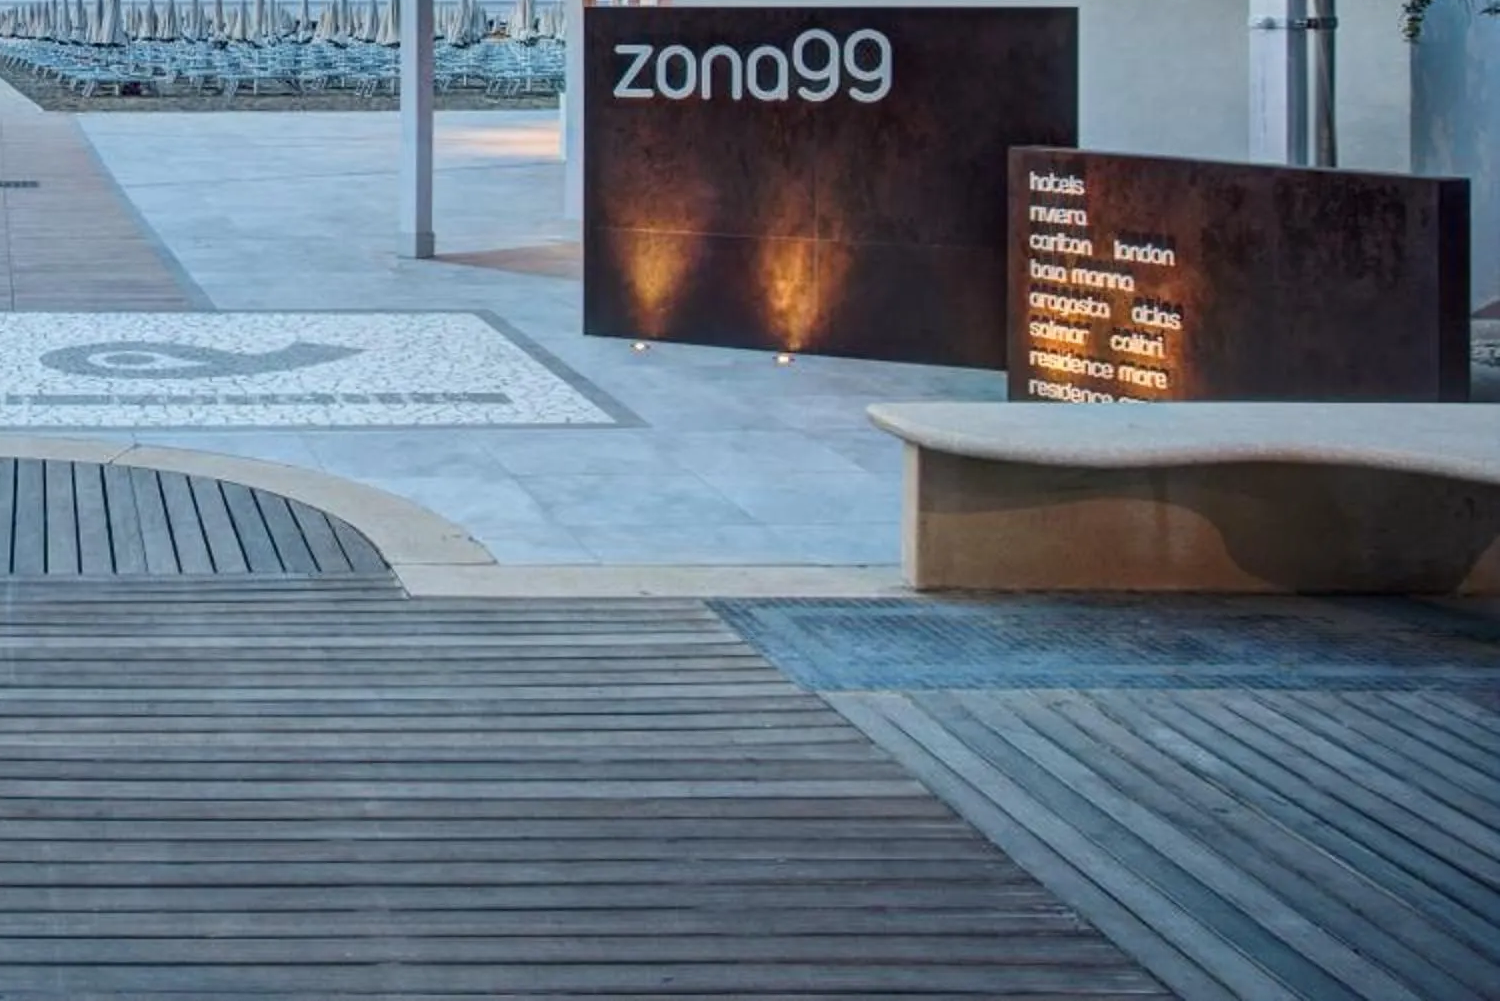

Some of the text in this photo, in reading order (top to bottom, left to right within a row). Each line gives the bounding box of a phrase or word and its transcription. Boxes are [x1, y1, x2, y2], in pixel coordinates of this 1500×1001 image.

[612, 28, 893, 103] zona99
[1029, 171, 1086, 196] hotels
[1029, 205, 1088, 227] riviera
[1029, 233, 1094, 257] carlton
[1113, 240, 1176, 267] london
[1030, 258, 1067, 284] baia
[1029, 292, 1111, 319] aragosta
[1131, 304, 1183, 330] atlas
[1110, 333, 1166, 359] colibri
[1029, 350, 1114, 380] residence
[1028, 378, 1113, 403] residence
